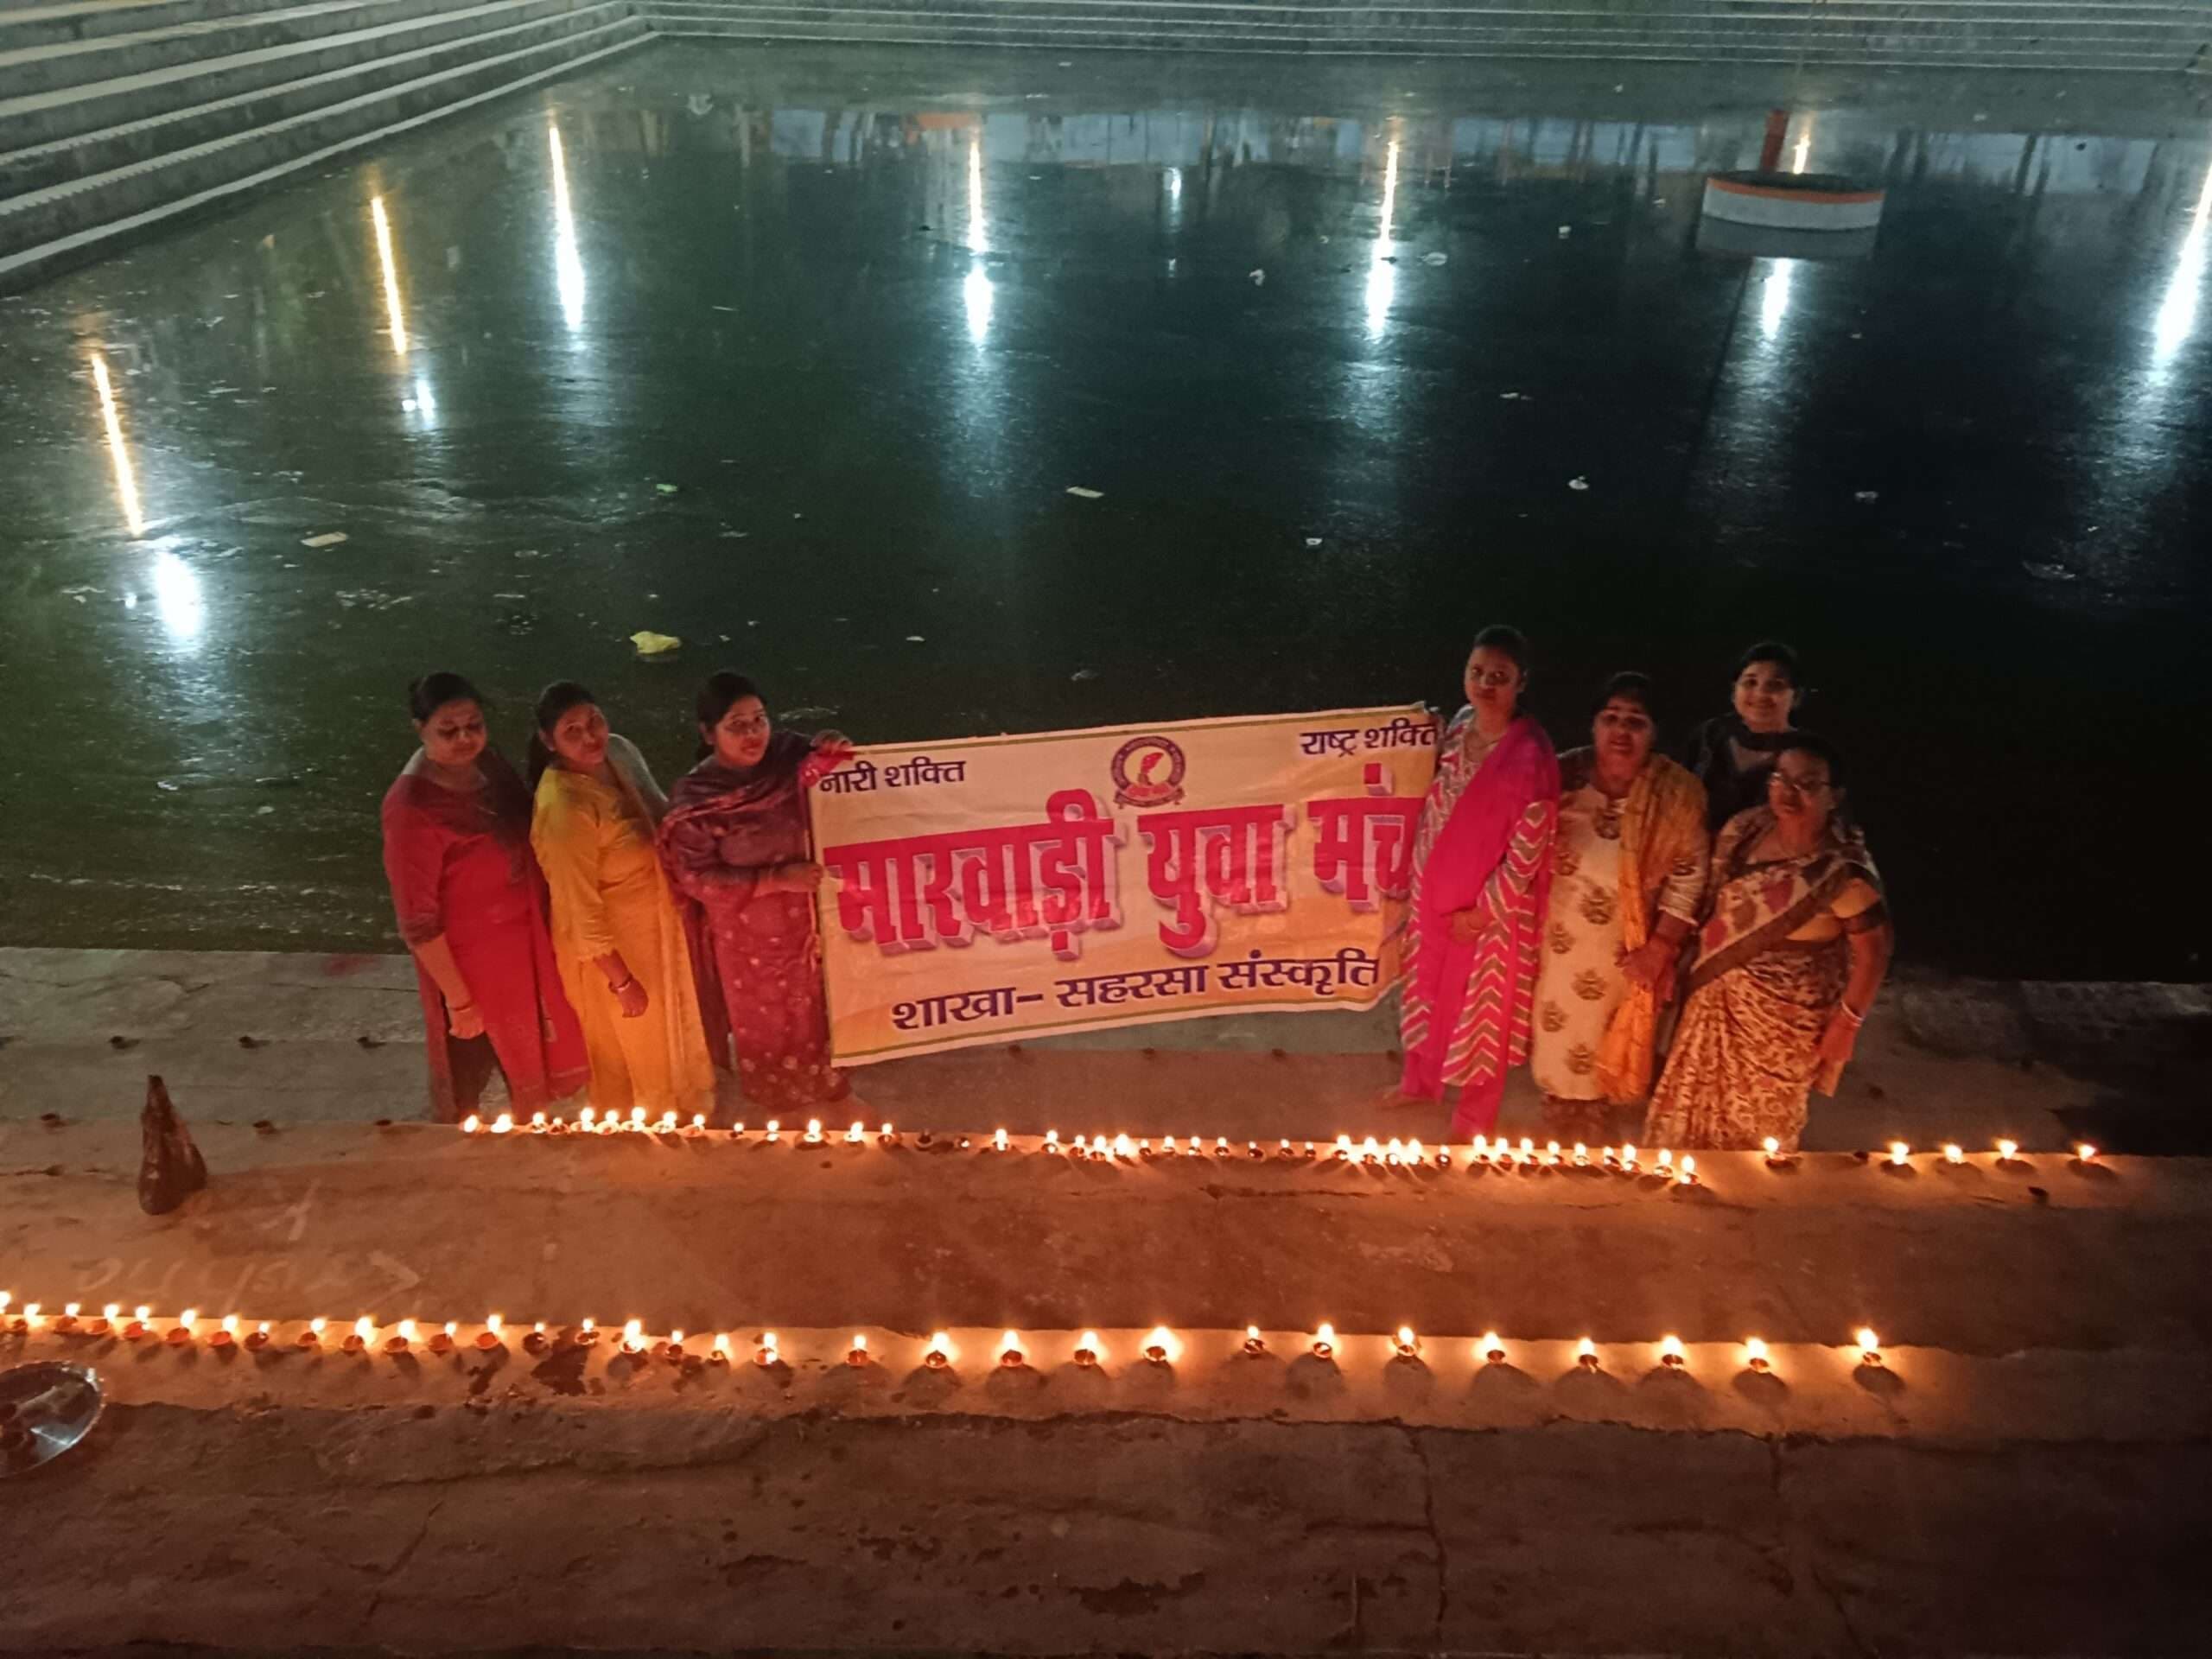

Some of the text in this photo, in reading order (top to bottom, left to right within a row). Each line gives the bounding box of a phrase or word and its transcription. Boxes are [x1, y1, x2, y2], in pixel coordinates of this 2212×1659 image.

[1300, 717, 1437, 758] राष्ट्र शक्ति
[819, 756, 966, 793] नारी शक्ति
[823, 789, 1121, 956] मारवाड़ी
[1137, 804, 1288, 955] युवा
[1307, 763, 1426, 909] मंच
[1054, 965, 1209, 1007] सहरसा
[1217, 948, 1379, 995] संस्कृति
